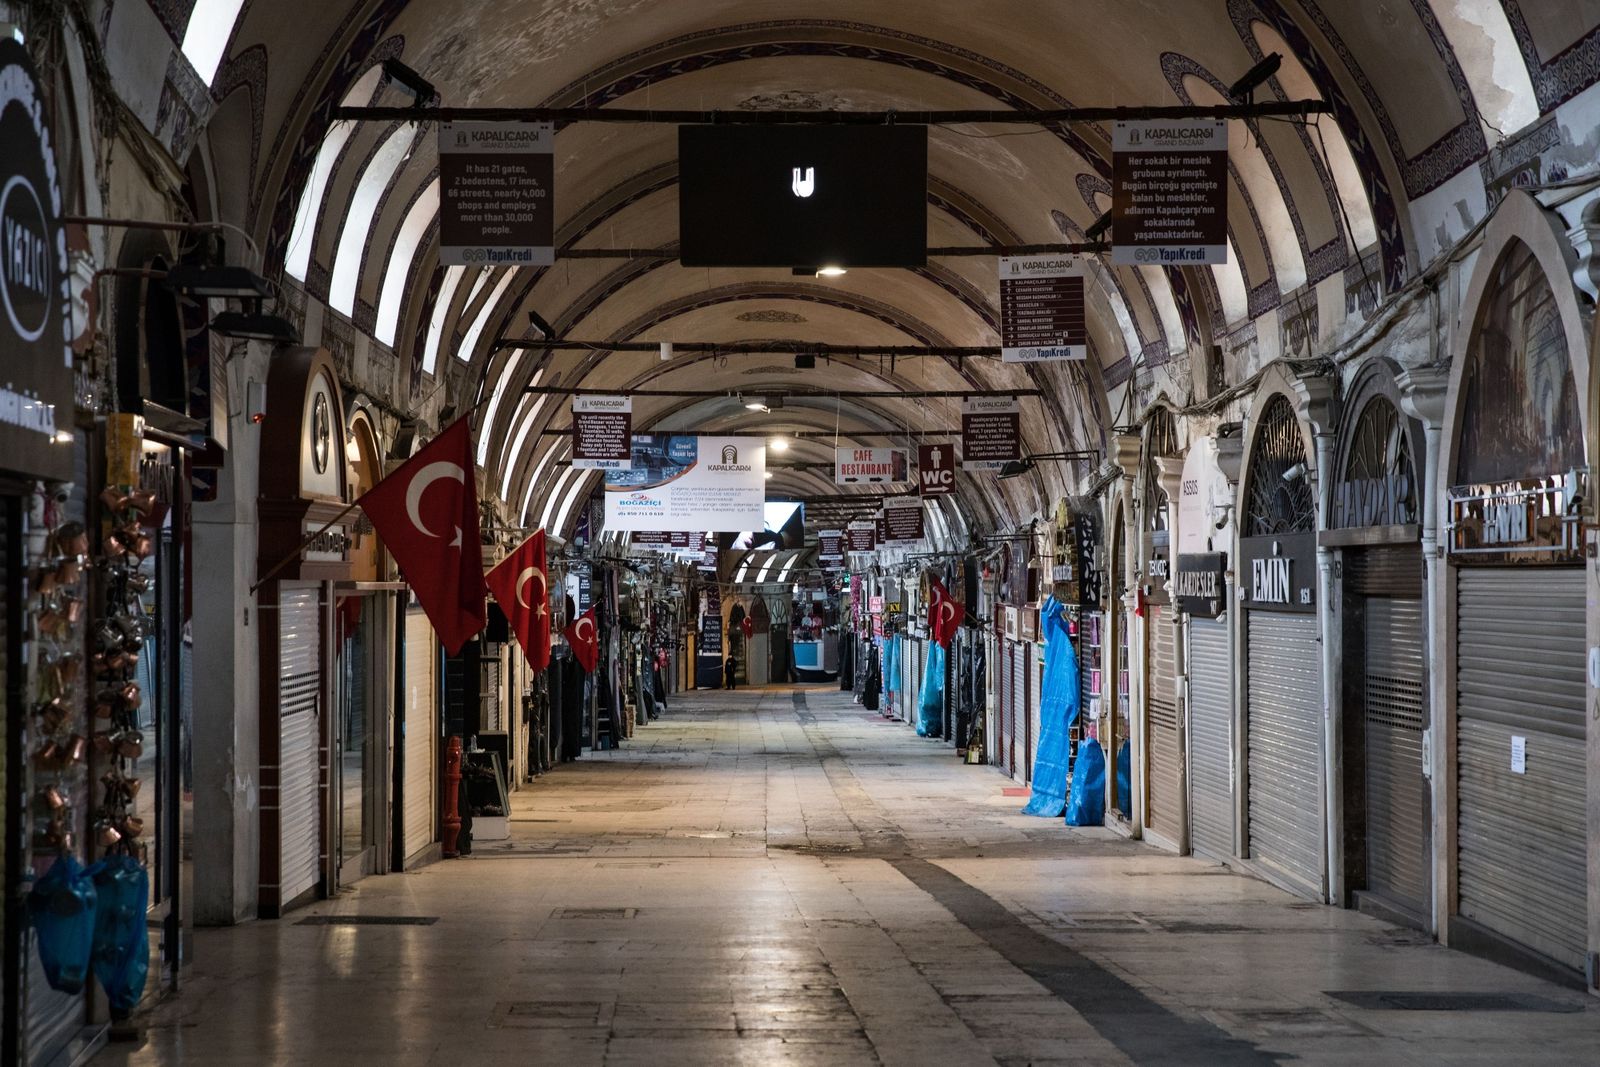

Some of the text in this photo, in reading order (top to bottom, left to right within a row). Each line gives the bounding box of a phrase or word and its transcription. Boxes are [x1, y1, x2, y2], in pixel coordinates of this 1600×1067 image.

[1129, 157, 1142, 165] Her
[1144, 157, 1168, 165] sokak
[1183, 156, 1211, 164] meslek
[502, 165, 527, 175] gates,
[1132, 169, 1207, 179] grubuna ayrılmıştı.
[462, 177, 507, 186] bedestens,
[519, 178, 538, 186] inns,
[1122, 181, 1217, 192] Bugün birçoğu geçmişte
[460, 190, 492, 198] streets,
[494, 189, 520, 199] nearly
[522, 189, 545, 198] 4,000
[1167, 194, 1207, 203] meslekler,
[458, 202, 482, 211] shops
[502, 202, 536, 211] employs
[1124, 206, 1215, 216] adlarını Kapalıçarşı'nın
[505, 214, 533, 222] 30,000
[1144, 218, 1195, 226] sokaklarında
[482, 226, 512, 235] people.
[1134, 230, 1205, 240] yaşatmaktadırlar.
[854, 450, 872, 462] CAFE
[841, 463, 892, 475] RESTAURANT
[922, 470, 953, 484] WC
[1184, 480, 1198, 496] ASSOS
[1336, 474, 1408, 528] HAYDAR
